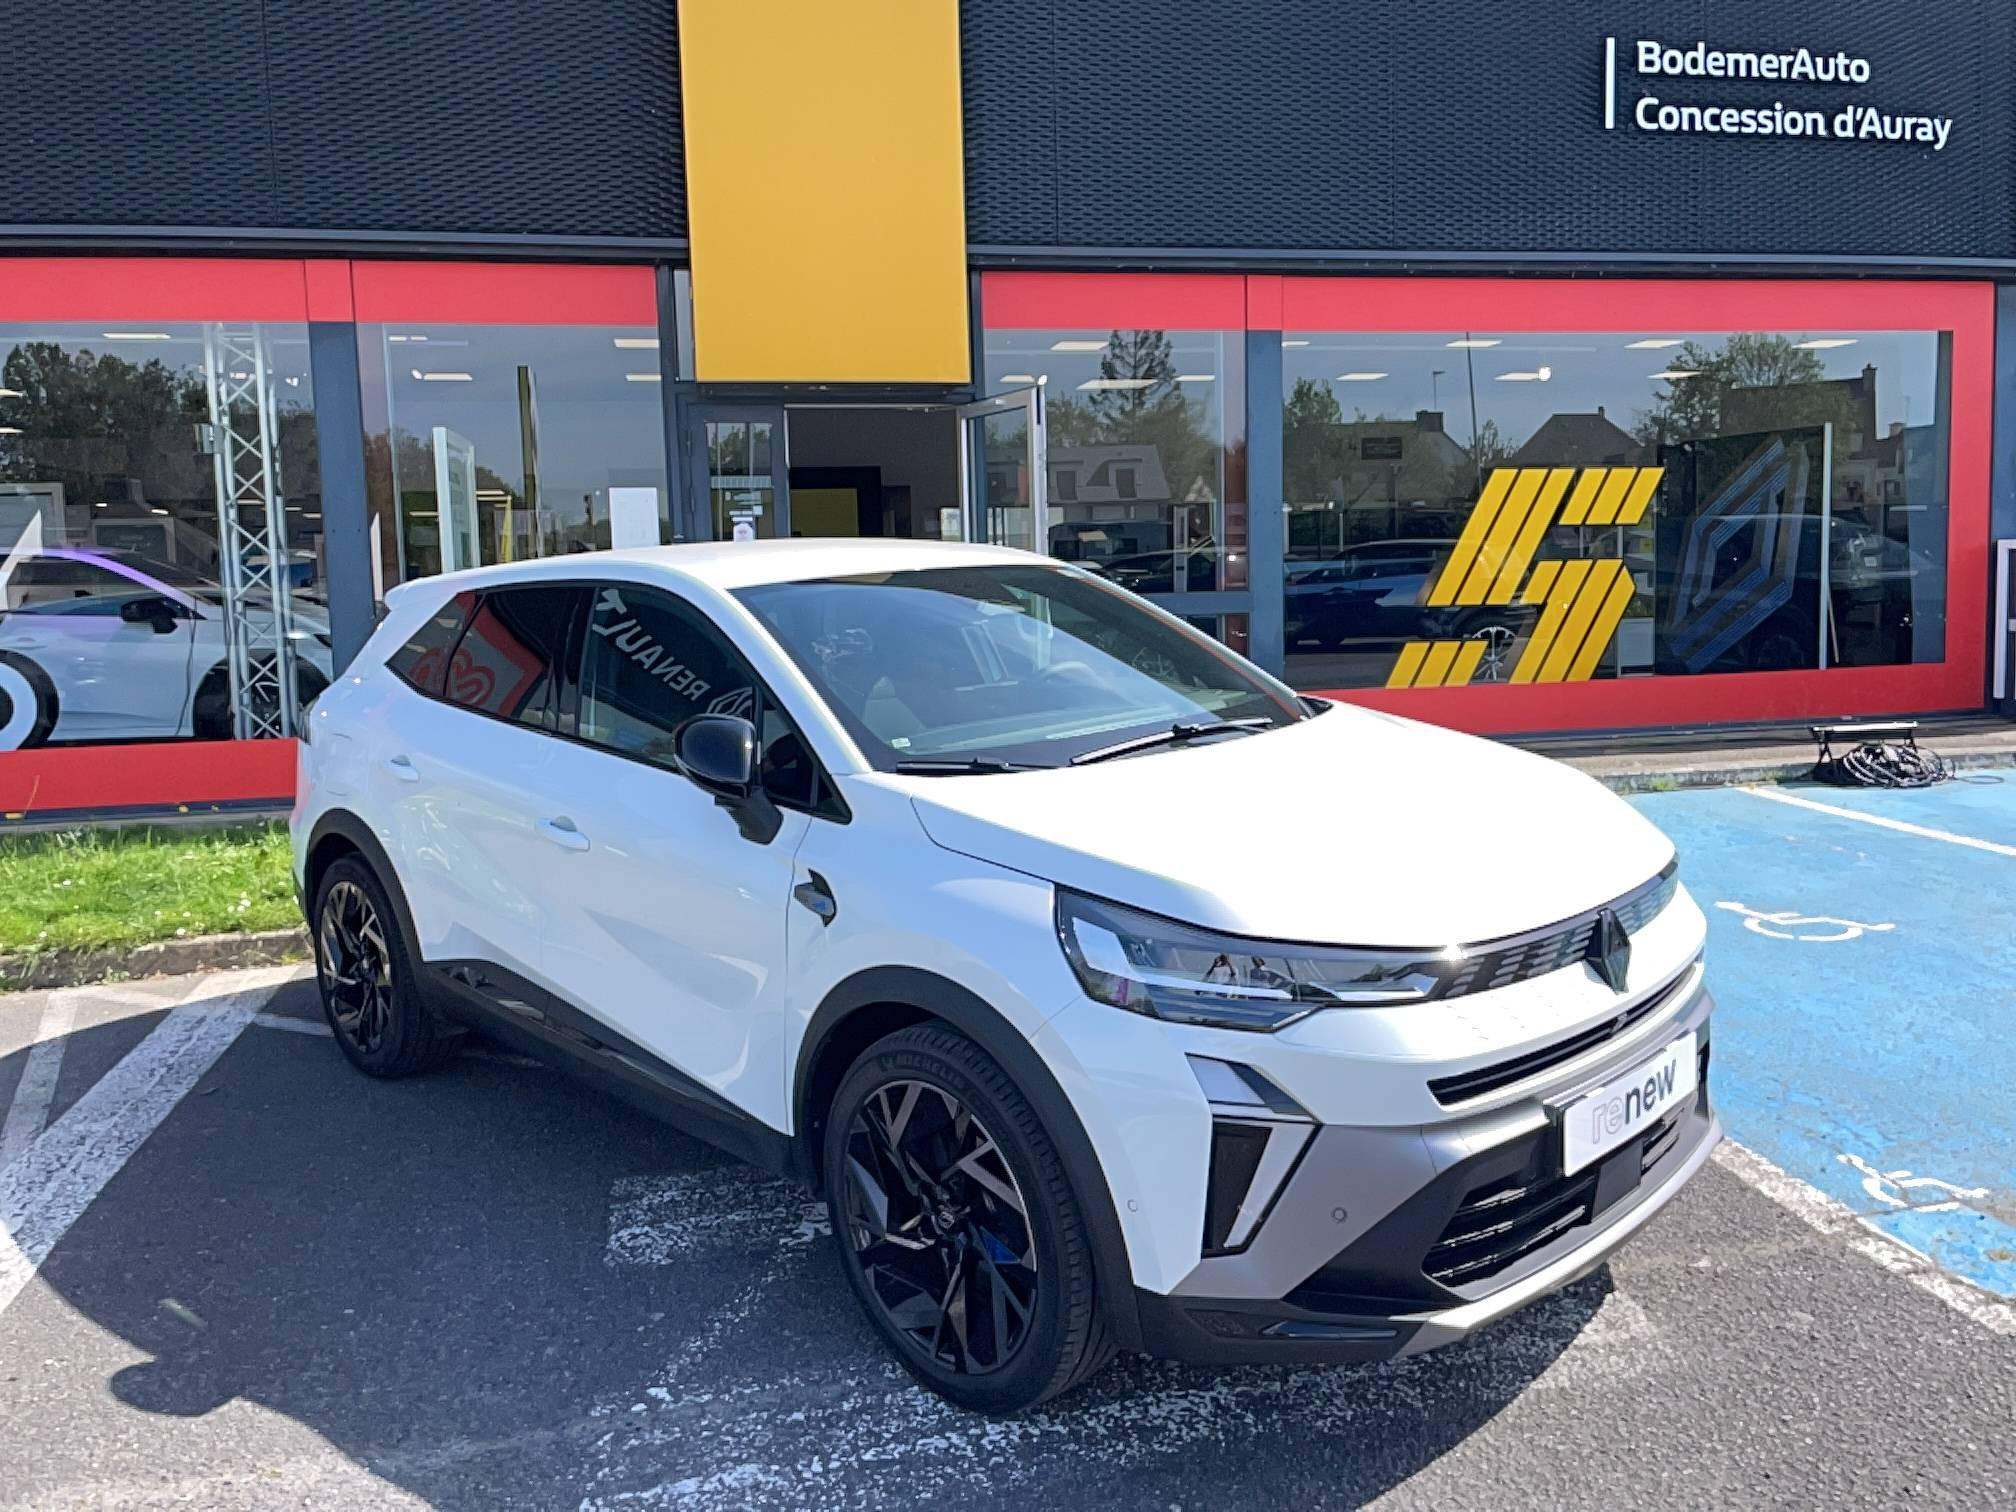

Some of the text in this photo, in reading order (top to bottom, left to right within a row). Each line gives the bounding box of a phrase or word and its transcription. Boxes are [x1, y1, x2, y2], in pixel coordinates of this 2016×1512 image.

[1637, 40, 1870, 83] BodemerAuto
[1635, 97, 1953, 150] Concession d'Auray
[1592, 1059, 1677, 1144] renew
